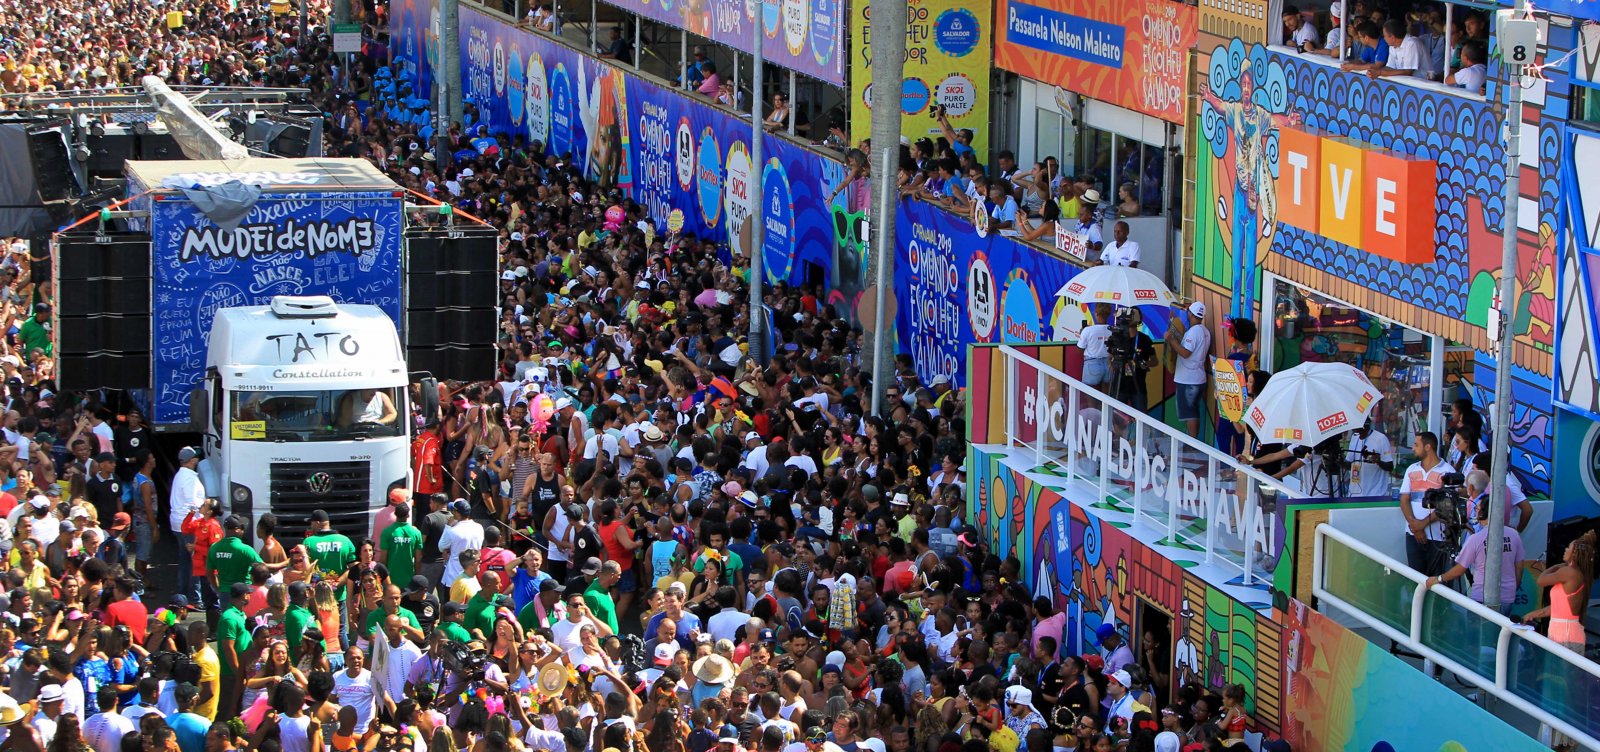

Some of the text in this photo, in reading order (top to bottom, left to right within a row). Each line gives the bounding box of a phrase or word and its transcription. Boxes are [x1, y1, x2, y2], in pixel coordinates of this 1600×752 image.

[1165, 6, 1177, 18] 2019
[1009, 7, 1121, 62] Passarela Nelson Maleiro
[1142, 14, 1181, 48] O MUNDO
[1143, 43, 1182, 81] ESCOLHEU
[1512, 45, 1527, 61] 8
[945, 86, 965, 94] SKOL
[1143, 76, 1182, 114] SALVADOR
[531, 102, 543, 118] PURO
[700, 165, 719, 187] Dorflex
[731, 176, 748, 200] SKOL
[1288, 150, 1398, 237] TVE
[731, 201, 748, 220] PURO
[276, 220, 306, 250] de
[766, 215, 788, 238] SALVADOR
[912, 222, 952, 254] CARNAVAL 2019
[908, 240, 959, 298] O MUNDO
[176, 296, 194, 308] EU
[1135, 290, 1156, 298] 107.5
[910, 282, 959, 346] ESCOLHEU
[1006, 315, 1038, 342] Dorflex
[160, 343, 203, 362] REAL
[265, 332, 360, 363] TATO
[180, 356, 201, 370] de
[910, 331, 958, 392] SALVADOR
[272, 368, 363, 379] Constellation
[1318, 413, 1345, 429] 107.5
[316, 541, 342, 553] STAFF
[393, 536, 412, 544] STAFF
[216, 551, 233, 559] STAFF
